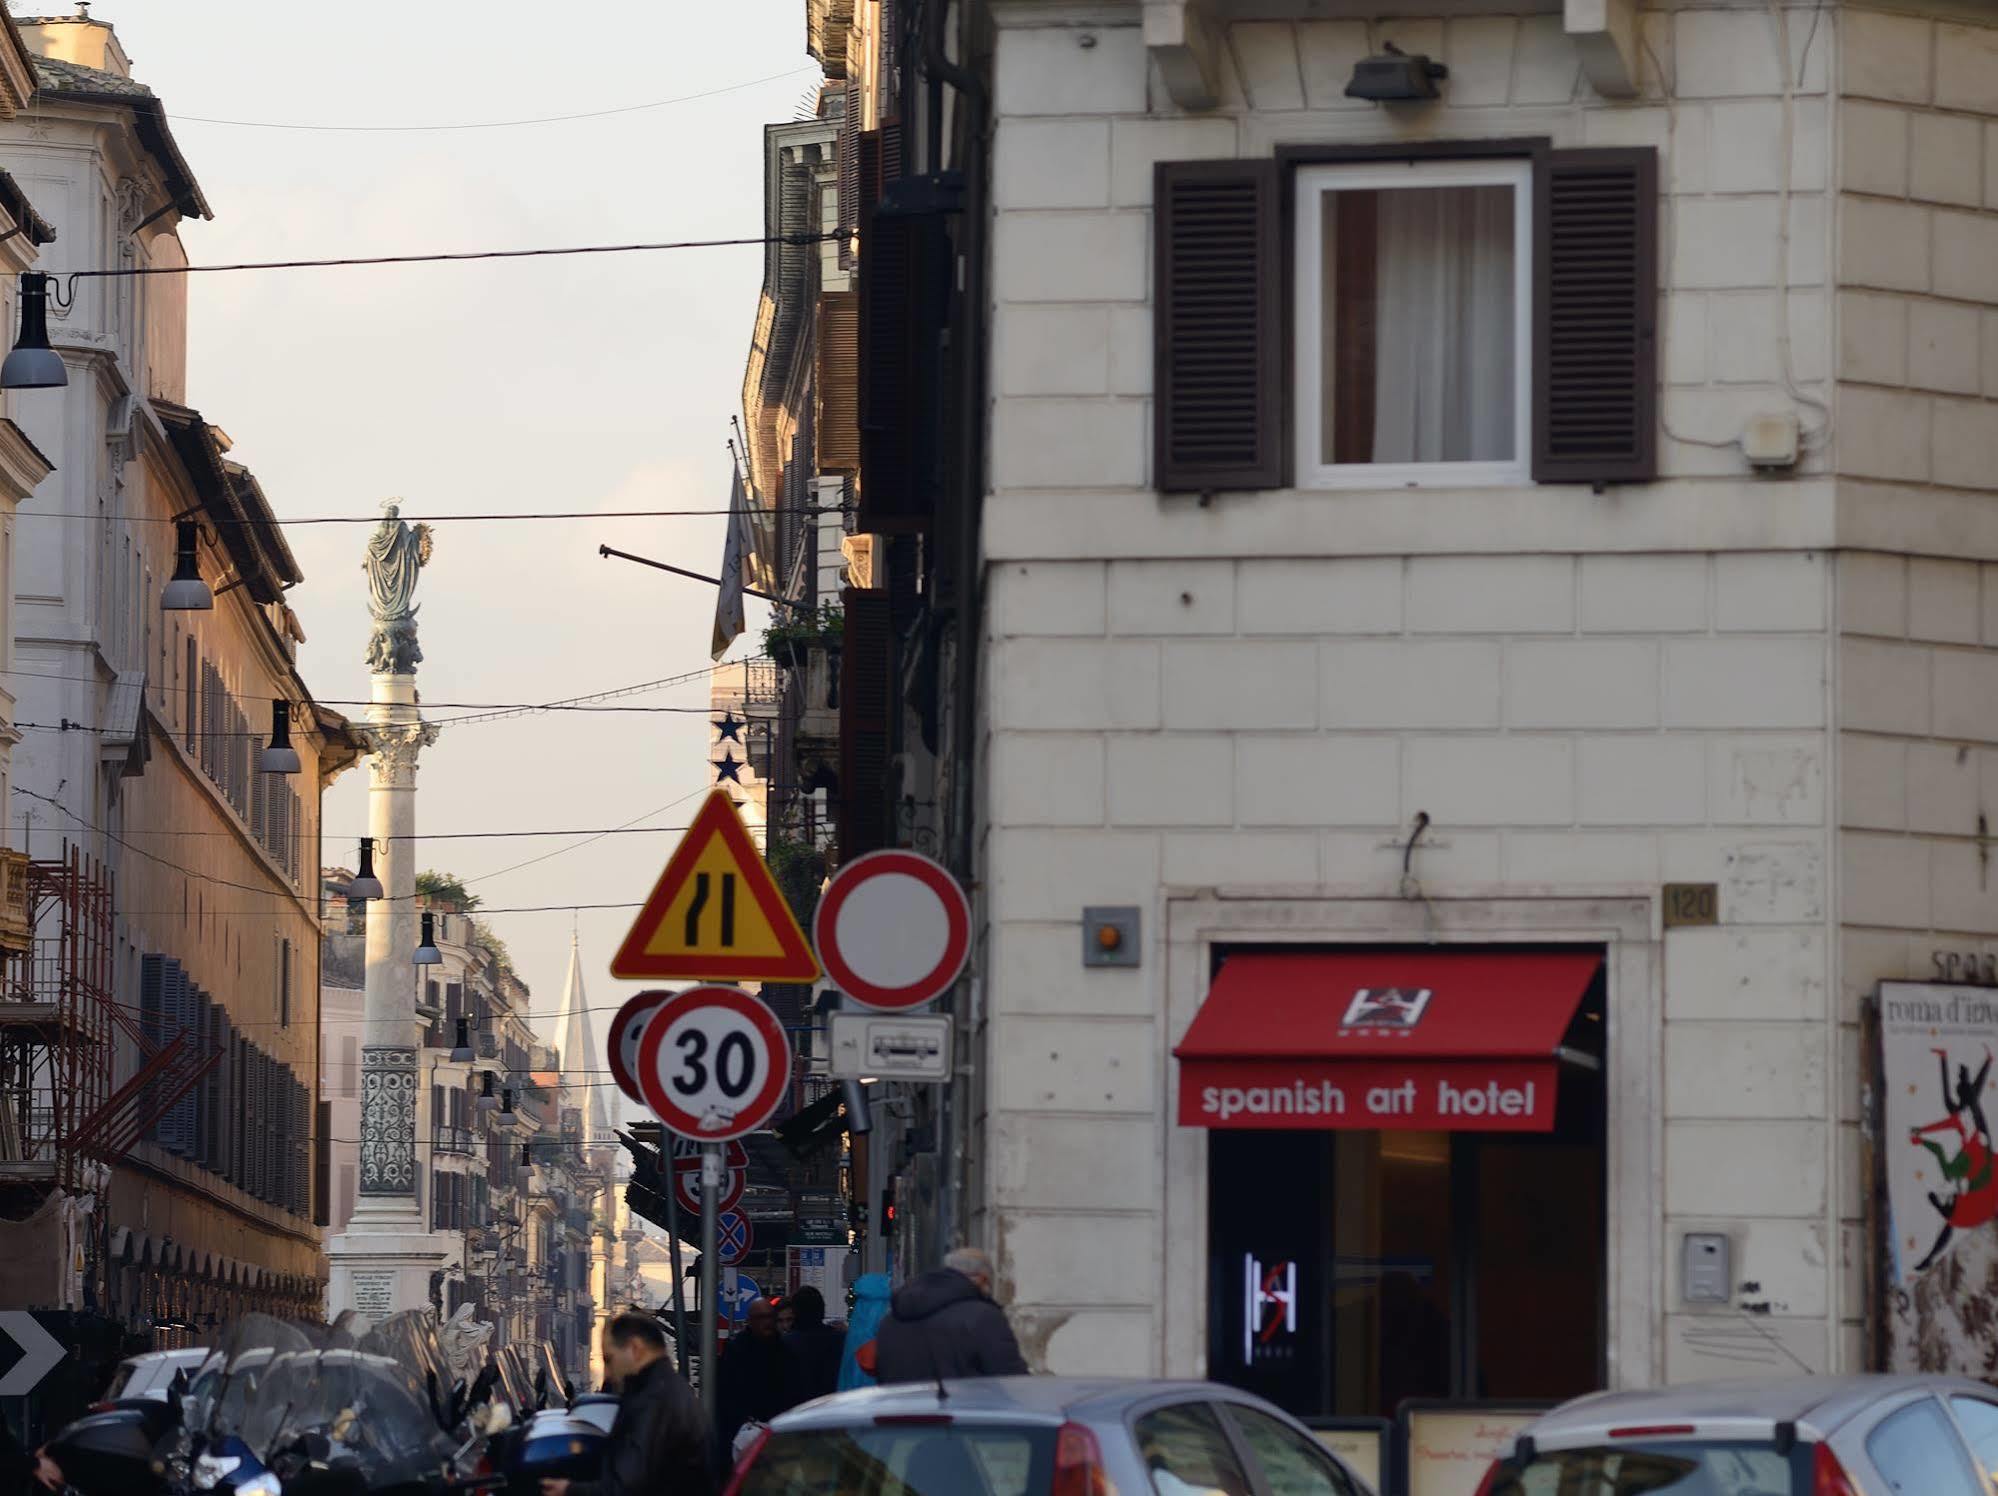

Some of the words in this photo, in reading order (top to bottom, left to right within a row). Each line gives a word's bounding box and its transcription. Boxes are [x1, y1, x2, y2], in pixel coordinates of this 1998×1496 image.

[1671, 887, 1713, 918] 120
[1888, 999, 1942, 1022] roma
[672, 1027, 756, 1099] 30
[1201, 1079, 1346, 1120] spanish
[1366, 1079, 1418, 1115] art
[1437, 1080, 1536, 1116] hotel
